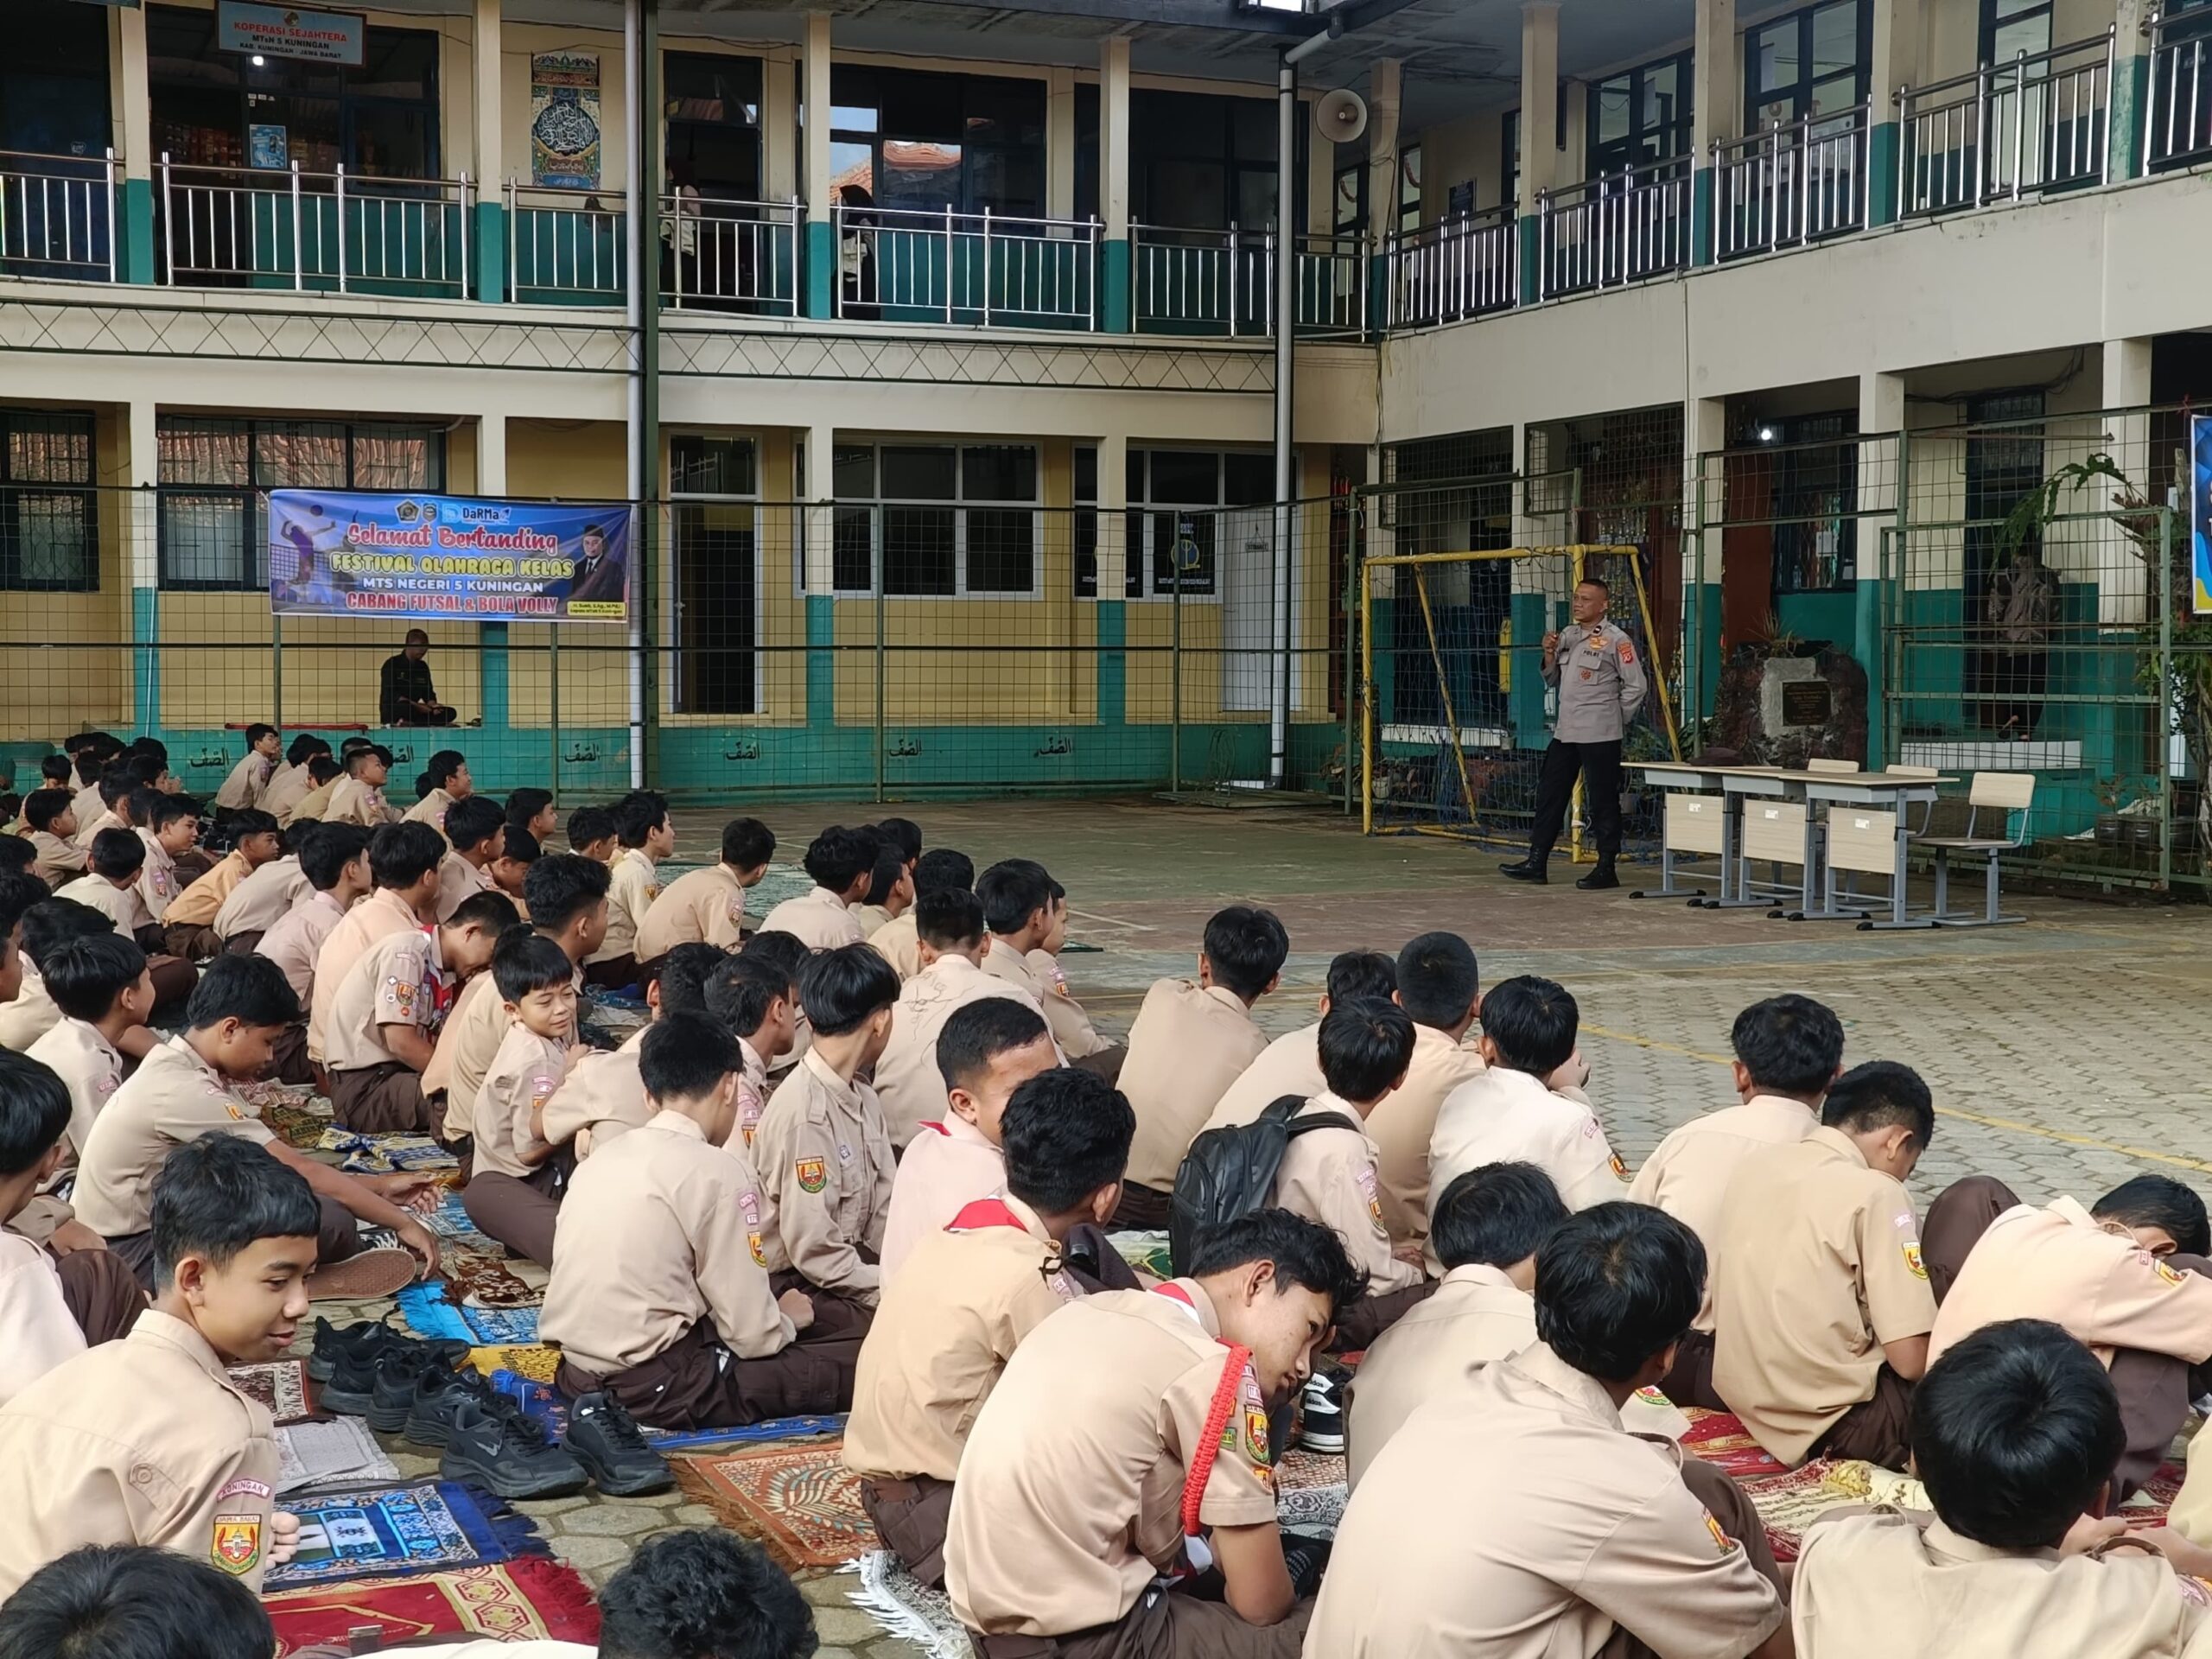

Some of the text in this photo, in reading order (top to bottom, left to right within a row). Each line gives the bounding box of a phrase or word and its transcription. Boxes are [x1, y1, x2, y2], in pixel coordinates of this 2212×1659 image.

[234, 22, 347, 41] KOPERASI SEJAHTERA
[251, 34, 275, 42] MTsN
[284, 38, 330, 49] KUNINGAN
[257, 45, 294, 54] KUNINGAN
[463, 507, 499, 519] DaRMa
[348, 523, 558, 556] Selamat Bertanding
[331, 553, 575, 578] FESTIVAL OLAHRAGA KELAS
[363, 577, 543, 593] MTS NEGERI 5 KUNINGAN
[346, 592, 558, 614] CABANG FUTSAL & BOLA VOLLY
